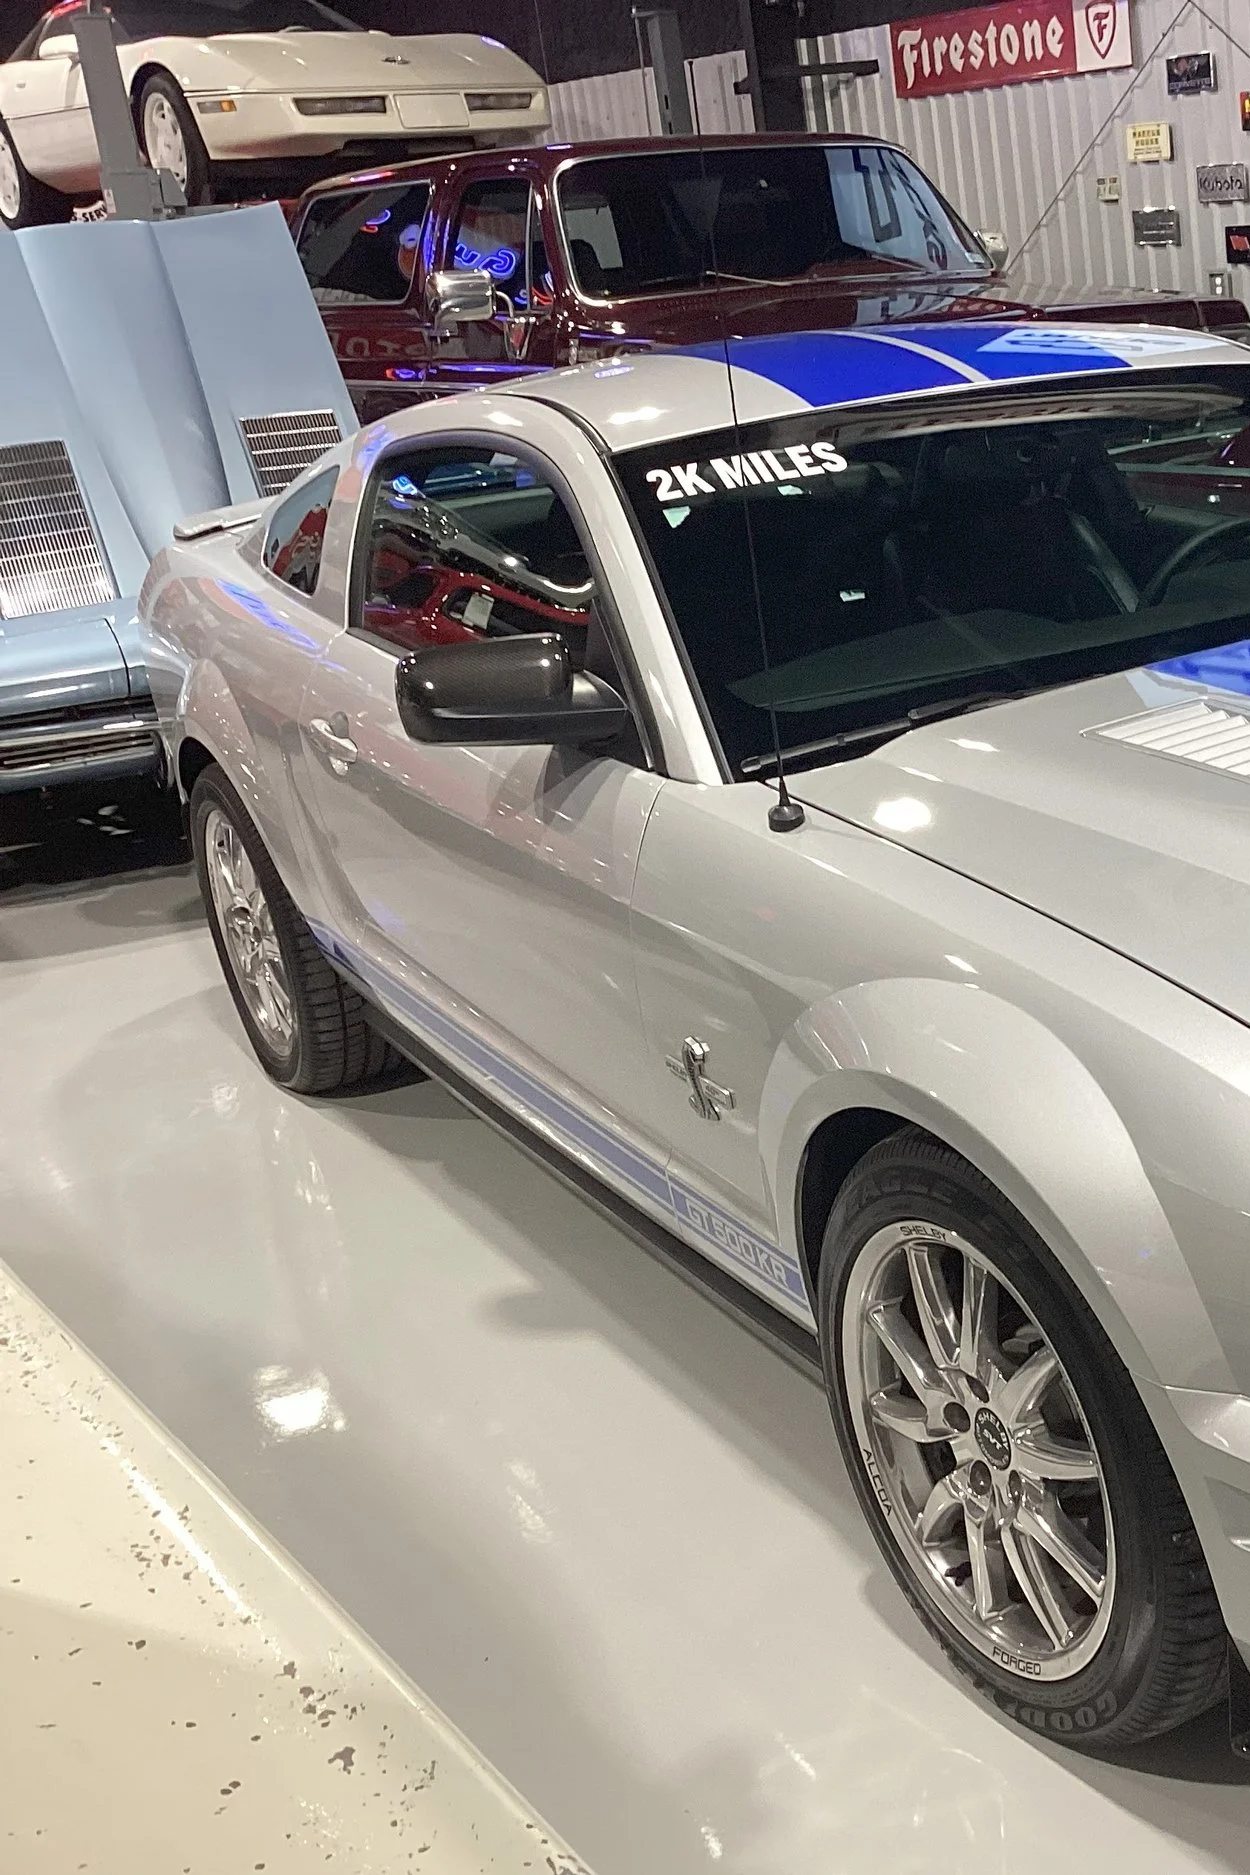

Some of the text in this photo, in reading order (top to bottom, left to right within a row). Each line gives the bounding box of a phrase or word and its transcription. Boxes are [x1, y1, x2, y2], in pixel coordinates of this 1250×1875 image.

[898, 15, 1064, 89] Firestone
[1200, 176, 1244, 191] Kubota
[646, 442, 848, 502] 2K MILES
[900, 1225, 947, 1242] SHELBY
[978, 1411, 1010, 1451] SHELBY
[863, 1448, 892, 1517] ALCOA
[993, 1646, 1042, 1676] FORGED
